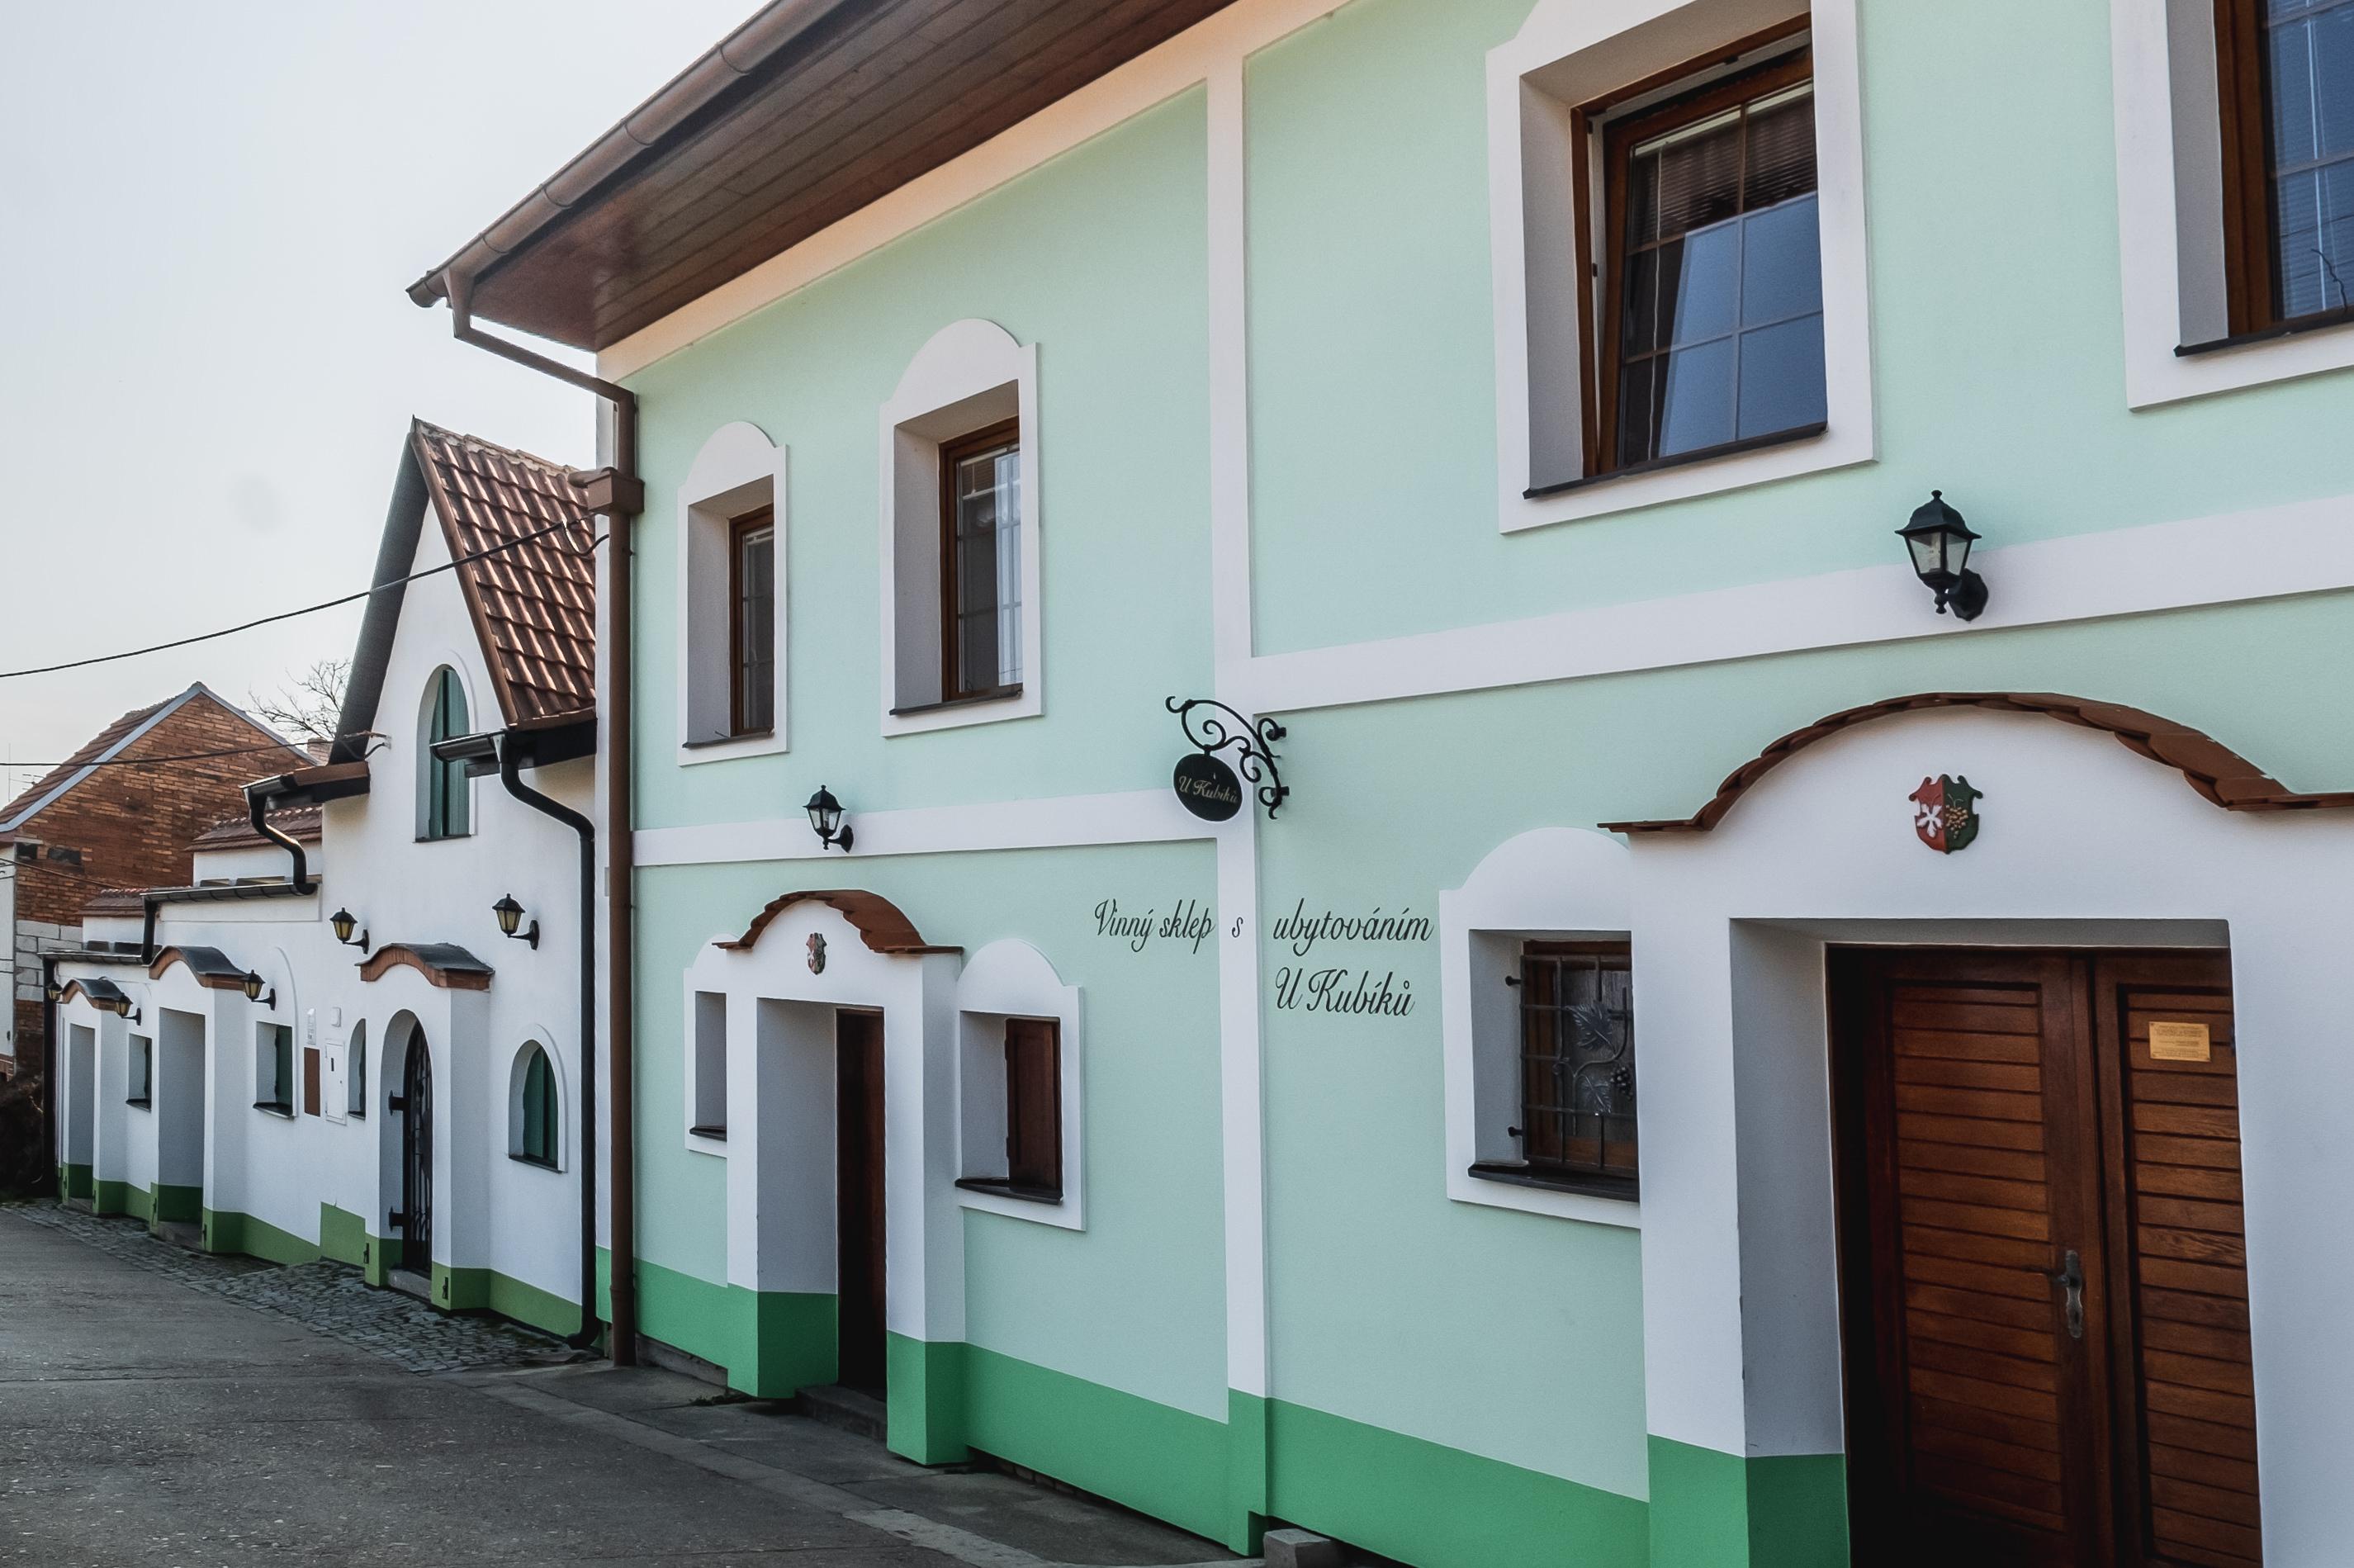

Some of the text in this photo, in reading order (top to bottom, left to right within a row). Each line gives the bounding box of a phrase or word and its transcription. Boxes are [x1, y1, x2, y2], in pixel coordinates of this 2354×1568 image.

[1178, 775, 1191, 793] U
[1094, 897, 1435, 957] Vinný sklep s ubytováním
[1275, 966, 1416, 1016] U Kubíků
